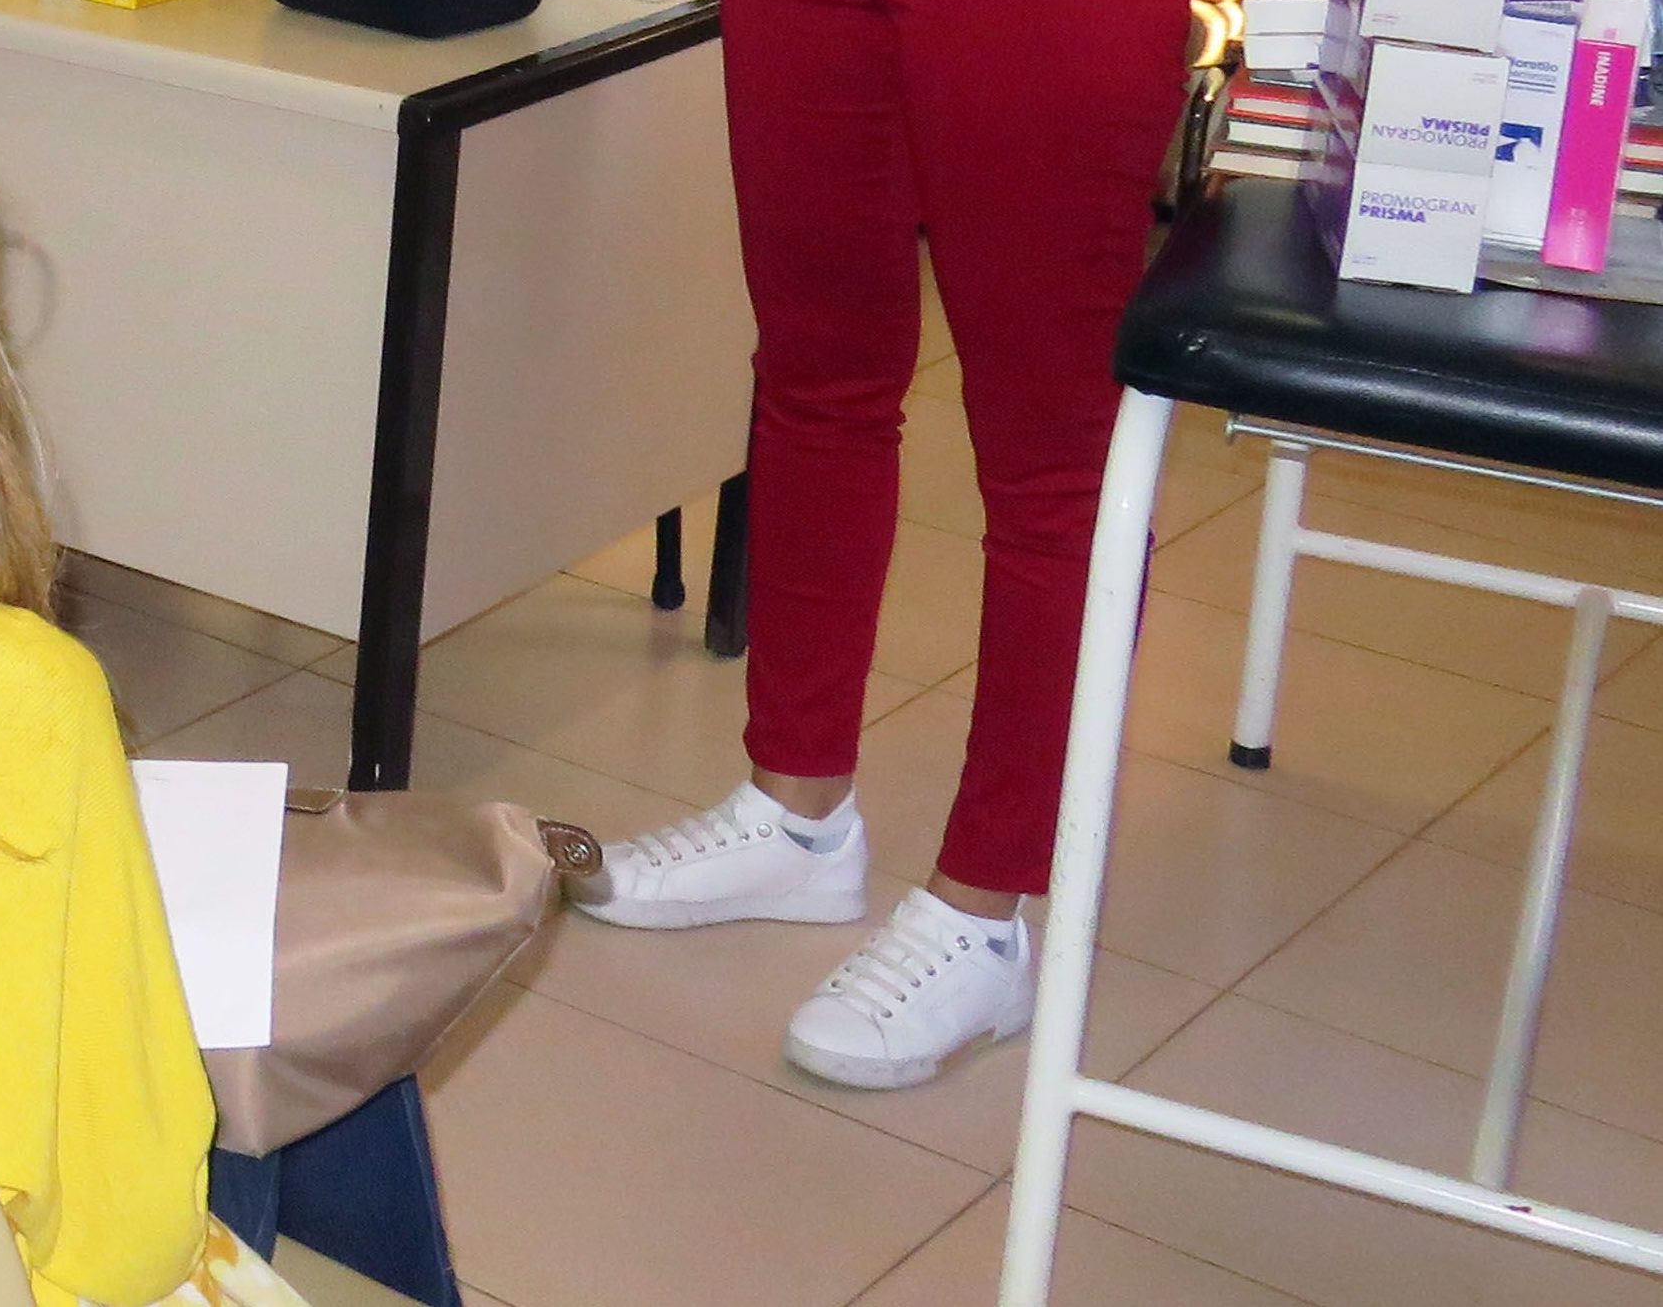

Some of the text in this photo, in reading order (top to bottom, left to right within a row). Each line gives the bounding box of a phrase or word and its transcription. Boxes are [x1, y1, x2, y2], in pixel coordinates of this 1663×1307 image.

[1589, 51, 1612, 106] INADINE
[1371, 123, 1488, 150] PROMOGRAN
[1421, 116, 1491, 137] PRISMA
[1358, 204, 1427, 223] PRISMA
[1360, 190, 1477, 215] PROMOGRAN
